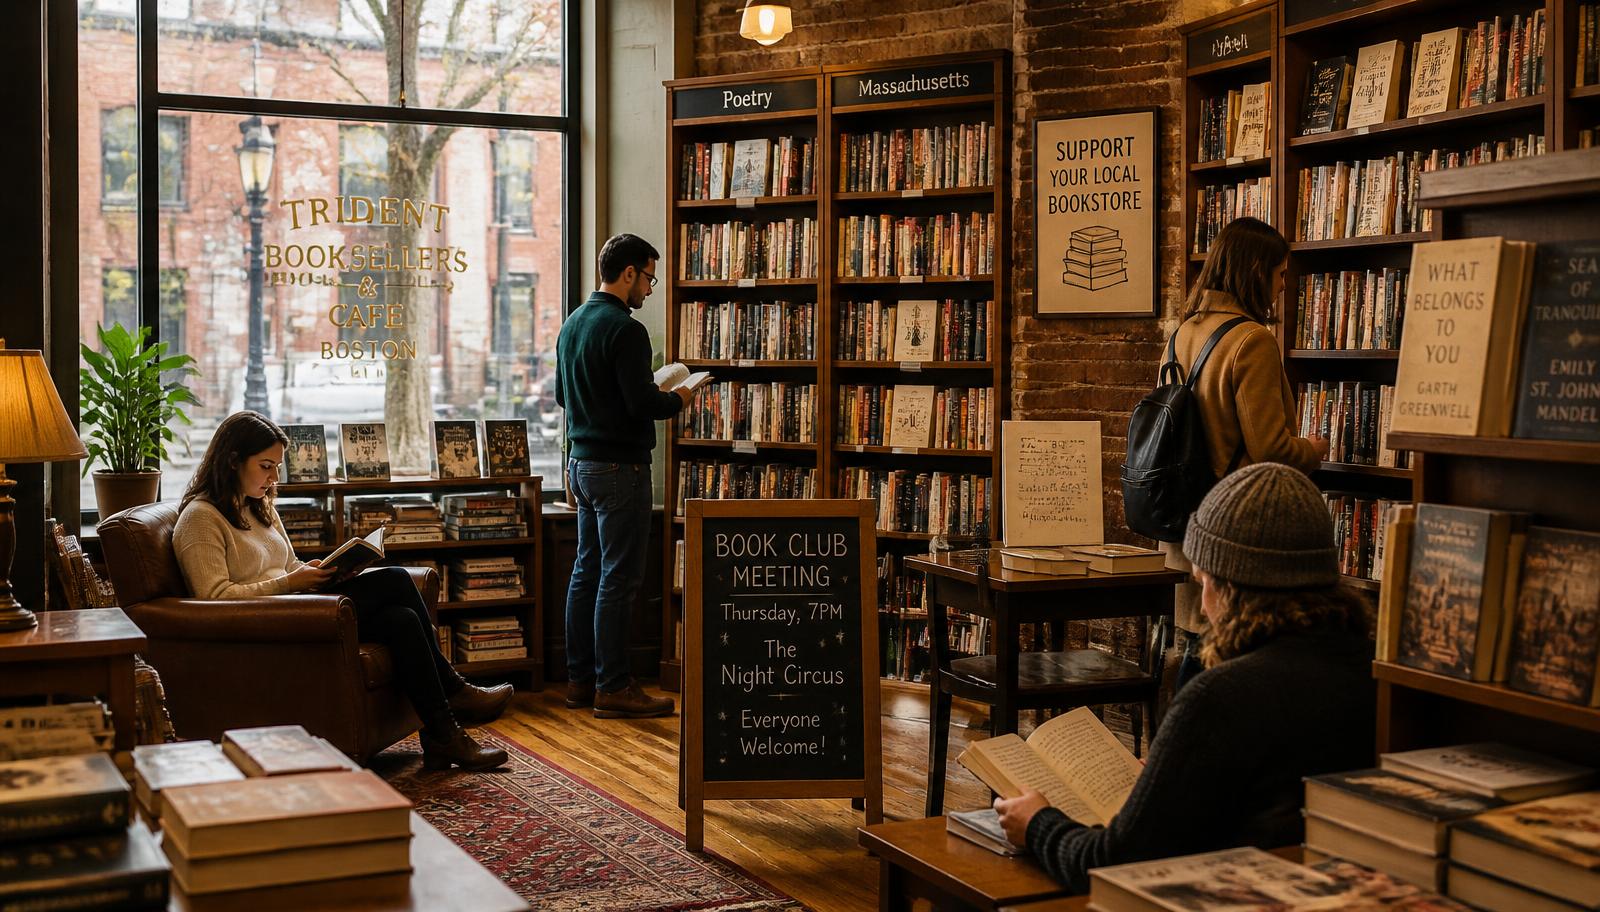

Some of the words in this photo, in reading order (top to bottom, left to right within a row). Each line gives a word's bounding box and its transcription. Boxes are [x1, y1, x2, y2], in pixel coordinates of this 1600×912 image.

[858, 72, 970, 97] Massachusetts
[722, 90, 772, 109] Poetry
[1056, 136, 1134, 162] SUPPORT
[1050, 168, 1088, 188] YOUR
[1094, 165, 1140, 184] LOCAL
[1048, 191, 1142, 214] BOOKSTORE
[280, 196, 450, 232] TRIDENT
[264, 244, 468, 272] BOOKSELLERS
[1568, 257, 1598, 274] SEA
[1428, 261, 1480, 282] WHAT
[357, 275, 378, 299] &
[1570, 280, 1592, 298] OF
[1414, 292, 1484, 311] BELONGS
[1436, 318, 1455, 336] TO
[320, 340, 416, 360] BOSTON
[1426, 344, 1460, 364] YOU
[1550, 358, 1596, 376] EMILY
[1418, 382, 1457, 396] GARTH
[1530, 382, 1552, 398] ST.
[1557, 382, 1600, 399] JOHN
[1400, 402, 1472, 418] GREENWELL
[1536, 404, 1598, 422] MANDEL
[716, 534, 778, 557] BOOK
[788, 533, 848, 557] CLUB
[733, 565, 830, 588] MEETING
[720, 602, 800, 626] Thursday,
[808, 602, 842, 620] 7PM
[764, 640, 796, 658] The
[722, 664, 774, 692] Night
[784, 664, 844, 685] Circus
[741, 709, 820, 734] Everyone
[740, 736, 826, 756] Welcome!
